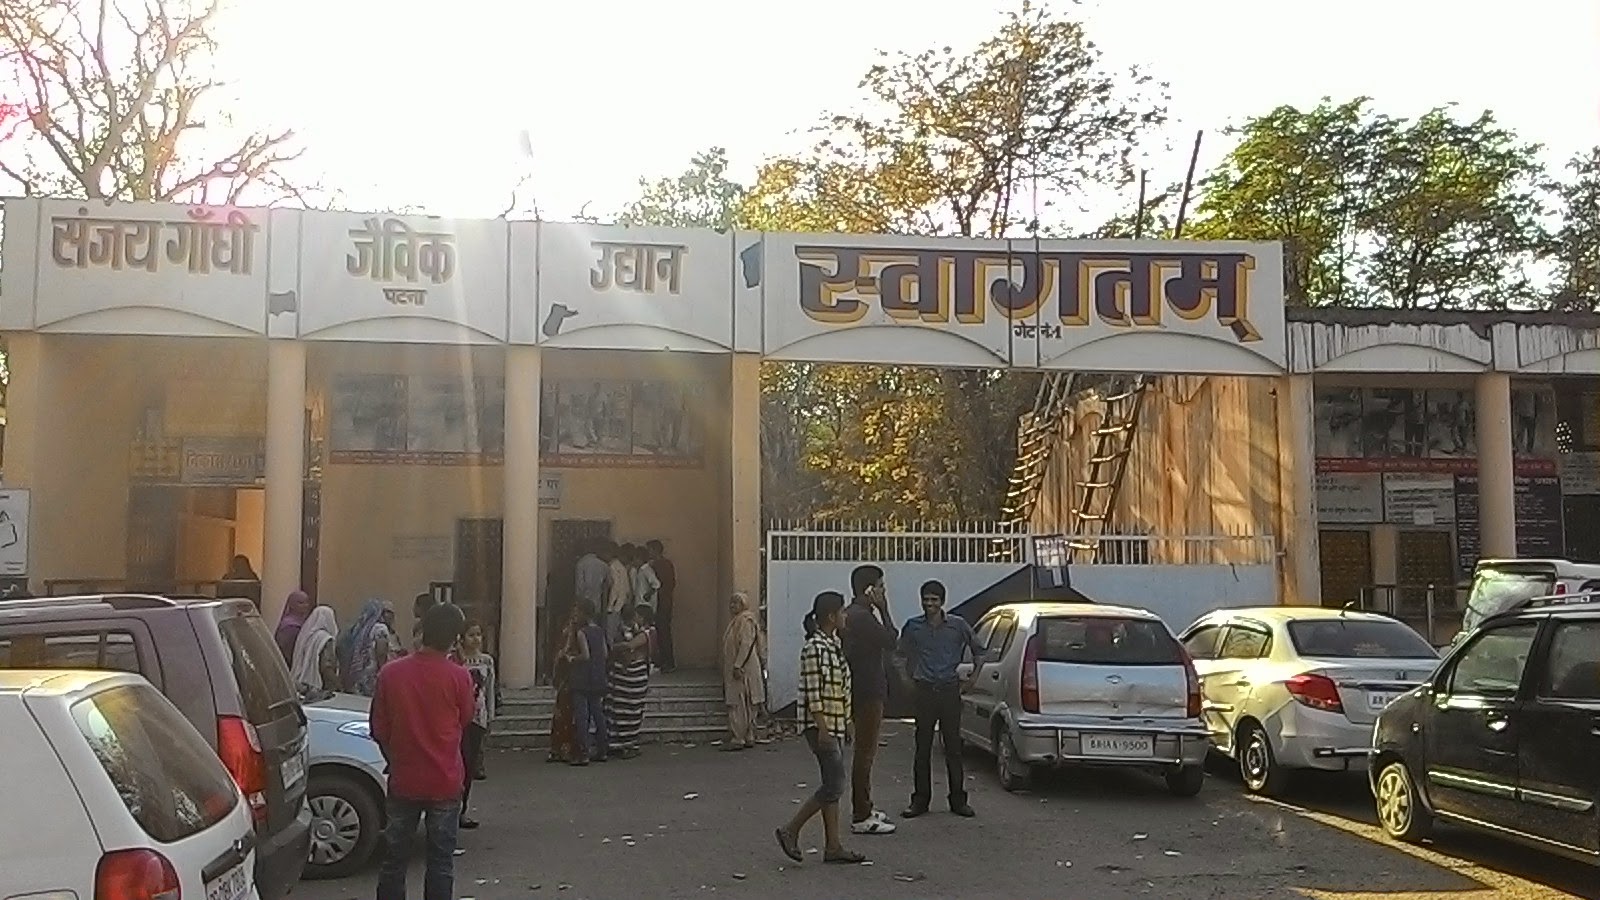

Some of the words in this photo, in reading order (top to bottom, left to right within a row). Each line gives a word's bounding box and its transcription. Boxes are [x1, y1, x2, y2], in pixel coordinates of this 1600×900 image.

[52, 206, 162, 273] संजय
[347, 219, 456, 284] जैविक
[590, 241, 689, 295] उद्यान
[795, 245, 1261, 343] स्वागतम्
[383, 289, 427, 305] पटना
